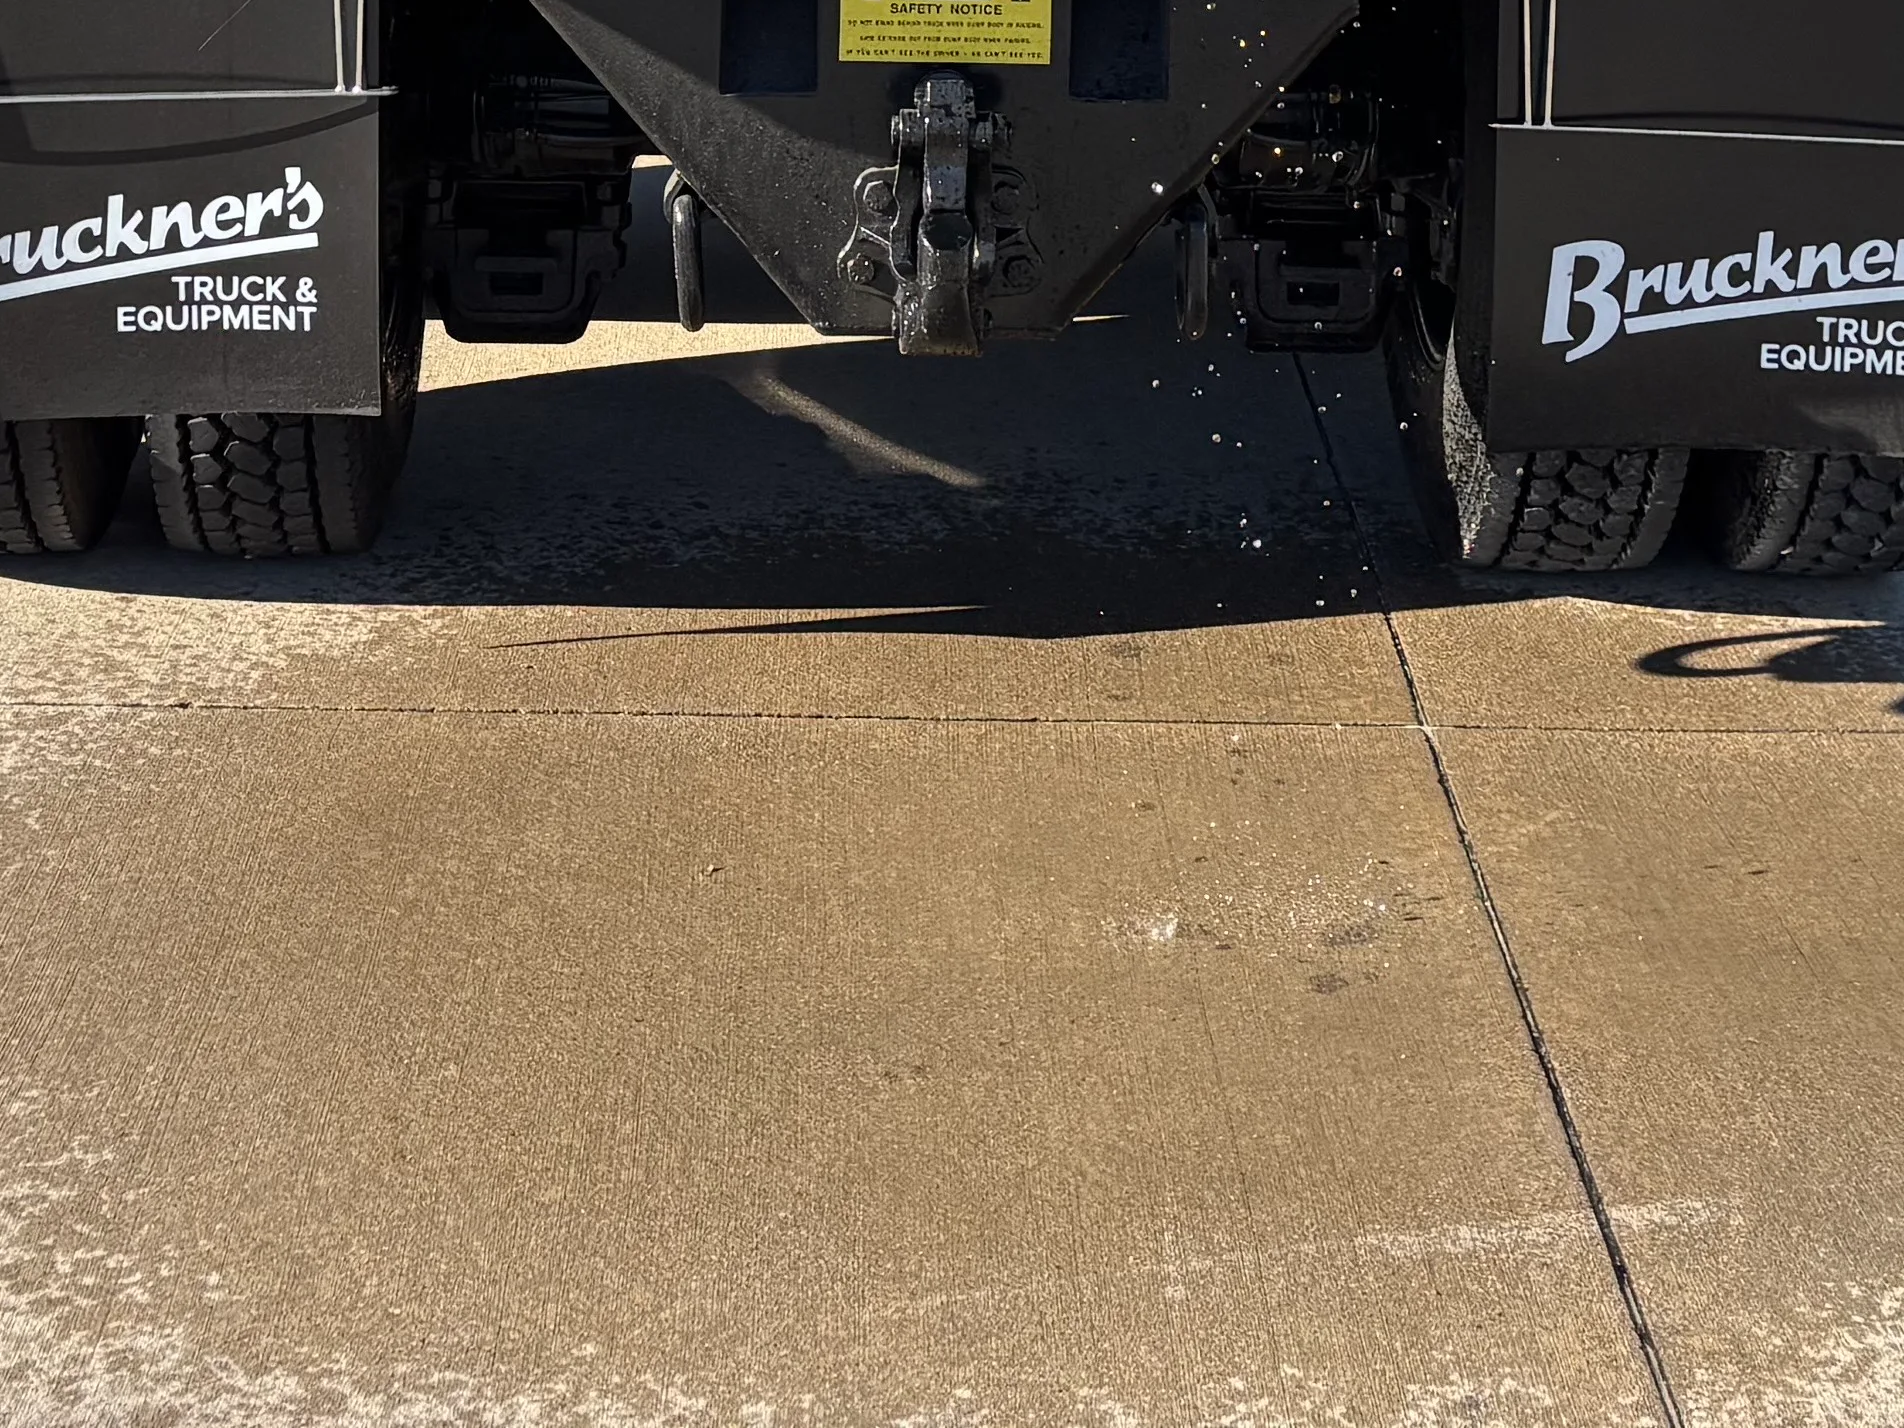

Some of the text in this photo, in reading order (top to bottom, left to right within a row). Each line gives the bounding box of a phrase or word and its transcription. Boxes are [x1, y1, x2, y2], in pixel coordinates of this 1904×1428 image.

[890, 2, 1003, 16] SAFETY NOTICE
[171, 275, 318, 302] TRUCK &
[116, 305, 318, 333] EQUIPMENT
